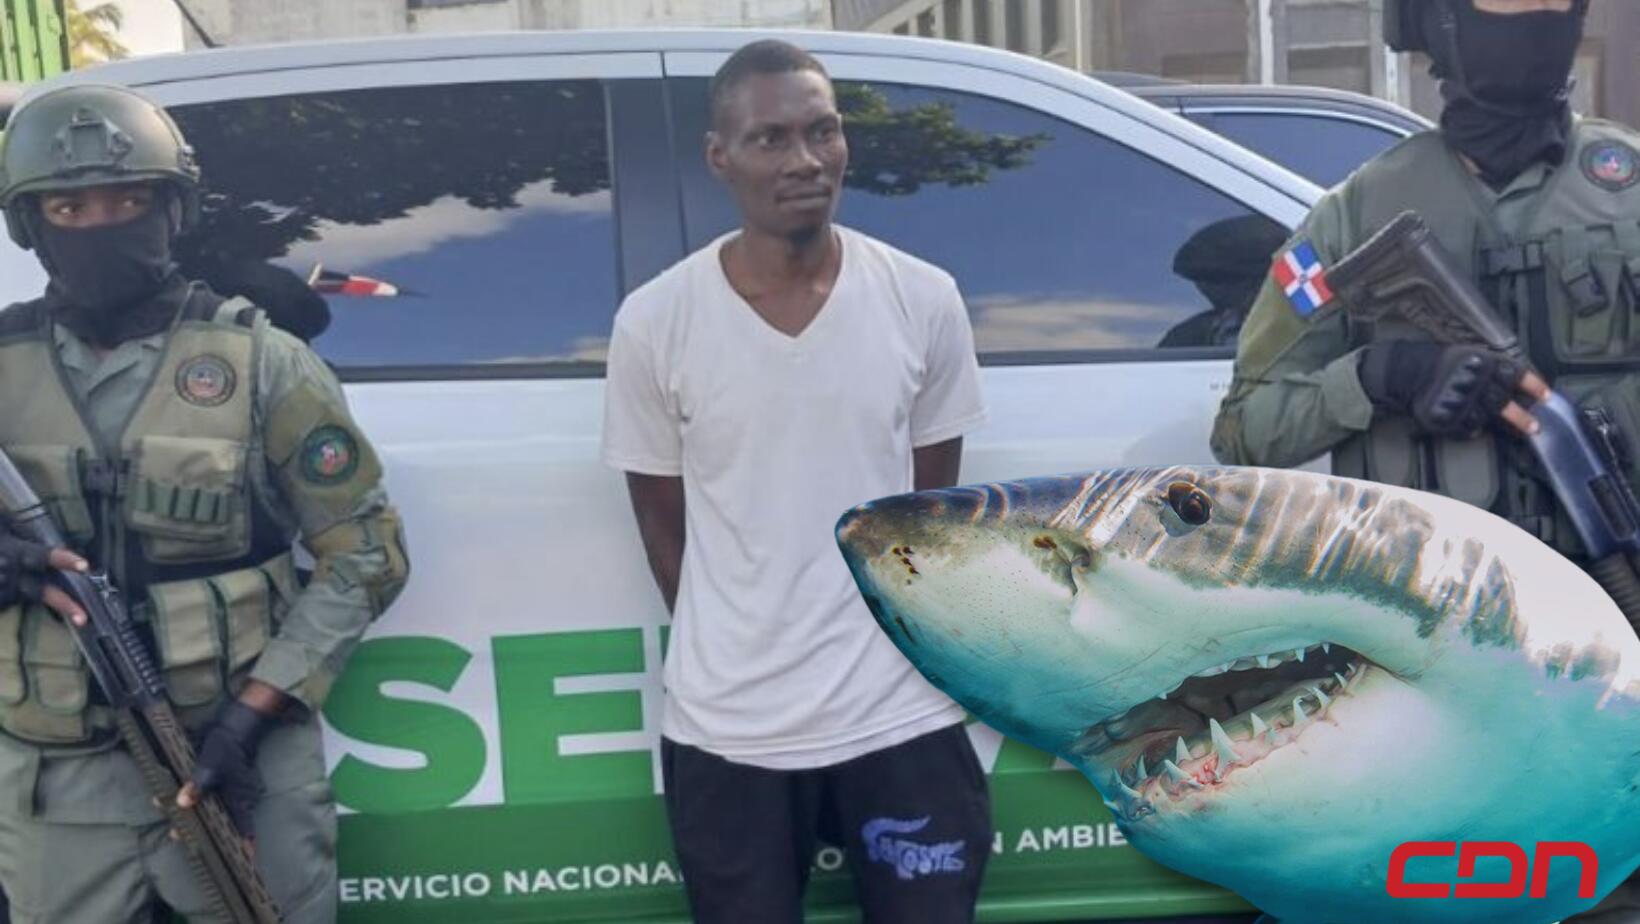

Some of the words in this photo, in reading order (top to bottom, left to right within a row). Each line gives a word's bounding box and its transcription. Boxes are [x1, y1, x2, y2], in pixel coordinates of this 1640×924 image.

[321, 625, 672, 813] SE
[338, 872, 491, 902] ERVICIO
[504, 860, 684, 894] NACIONA
[1016, 822, 1128, 852] AMBIE
